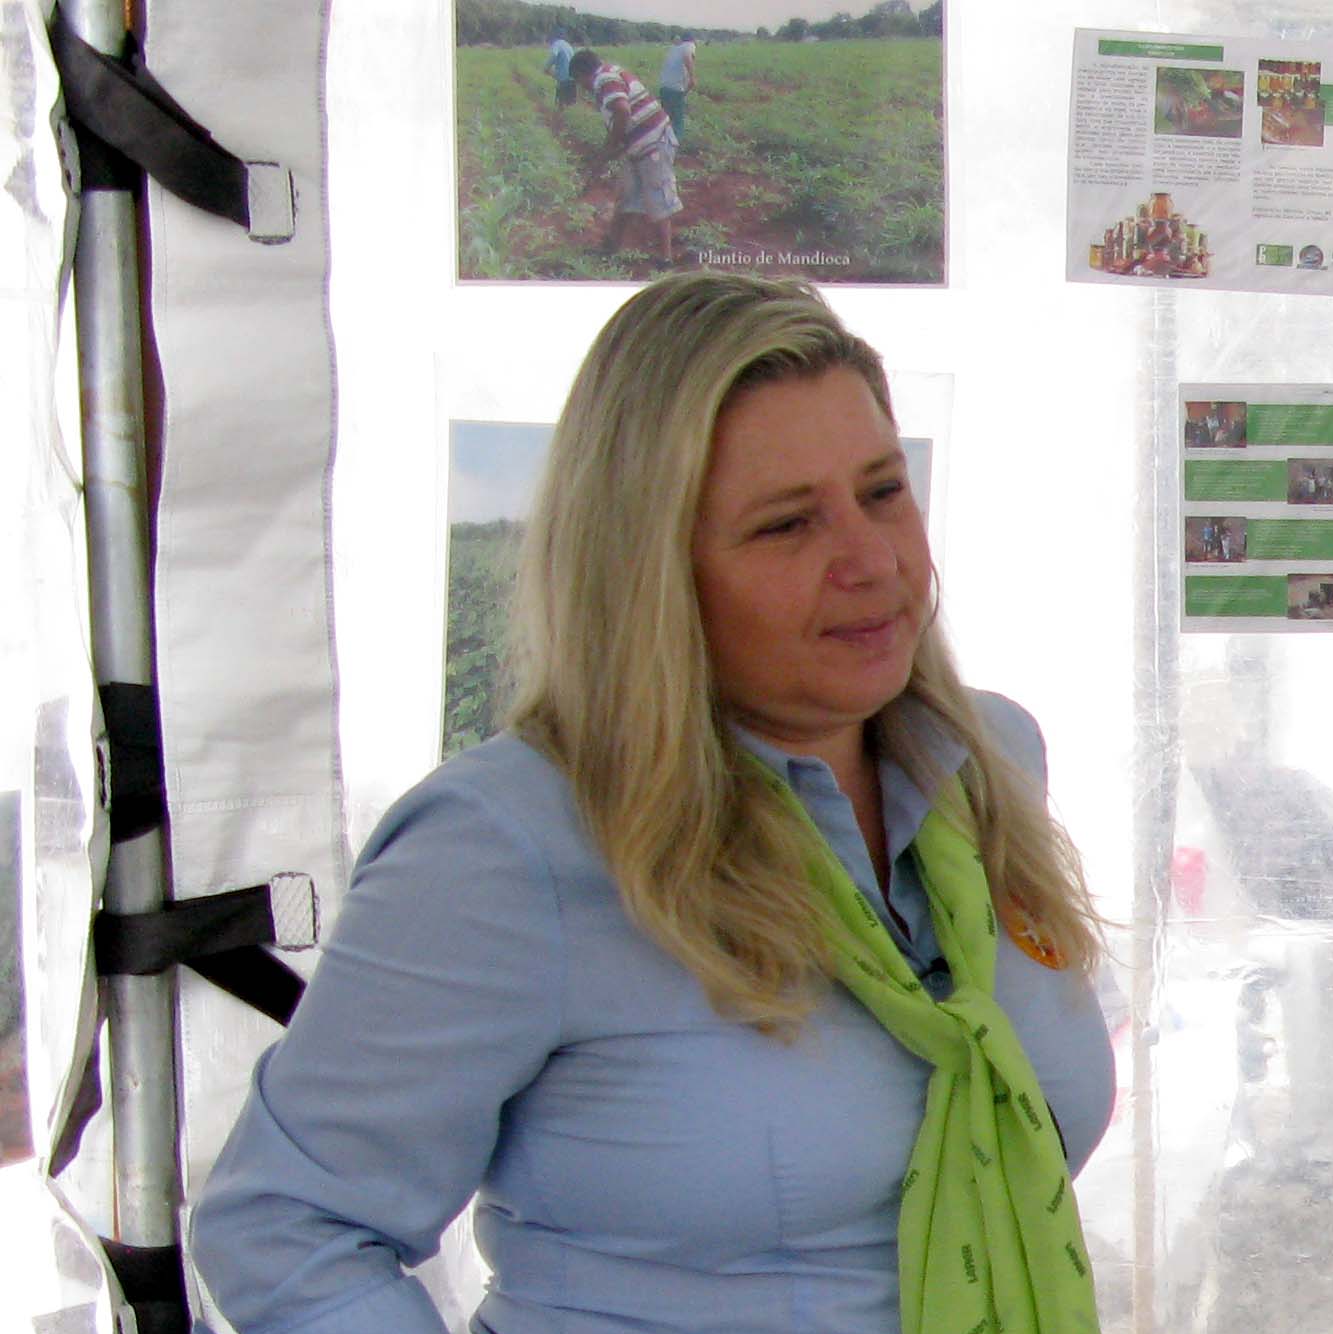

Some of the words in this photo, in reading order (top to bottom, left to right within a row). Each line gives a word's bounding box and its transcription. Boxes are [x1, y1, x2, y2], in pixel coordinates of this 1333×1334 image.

[699, 250, 751, 265] Plantio
[756, 250, 773, 265] de
[778, 251, 851, 265] Mandioca
